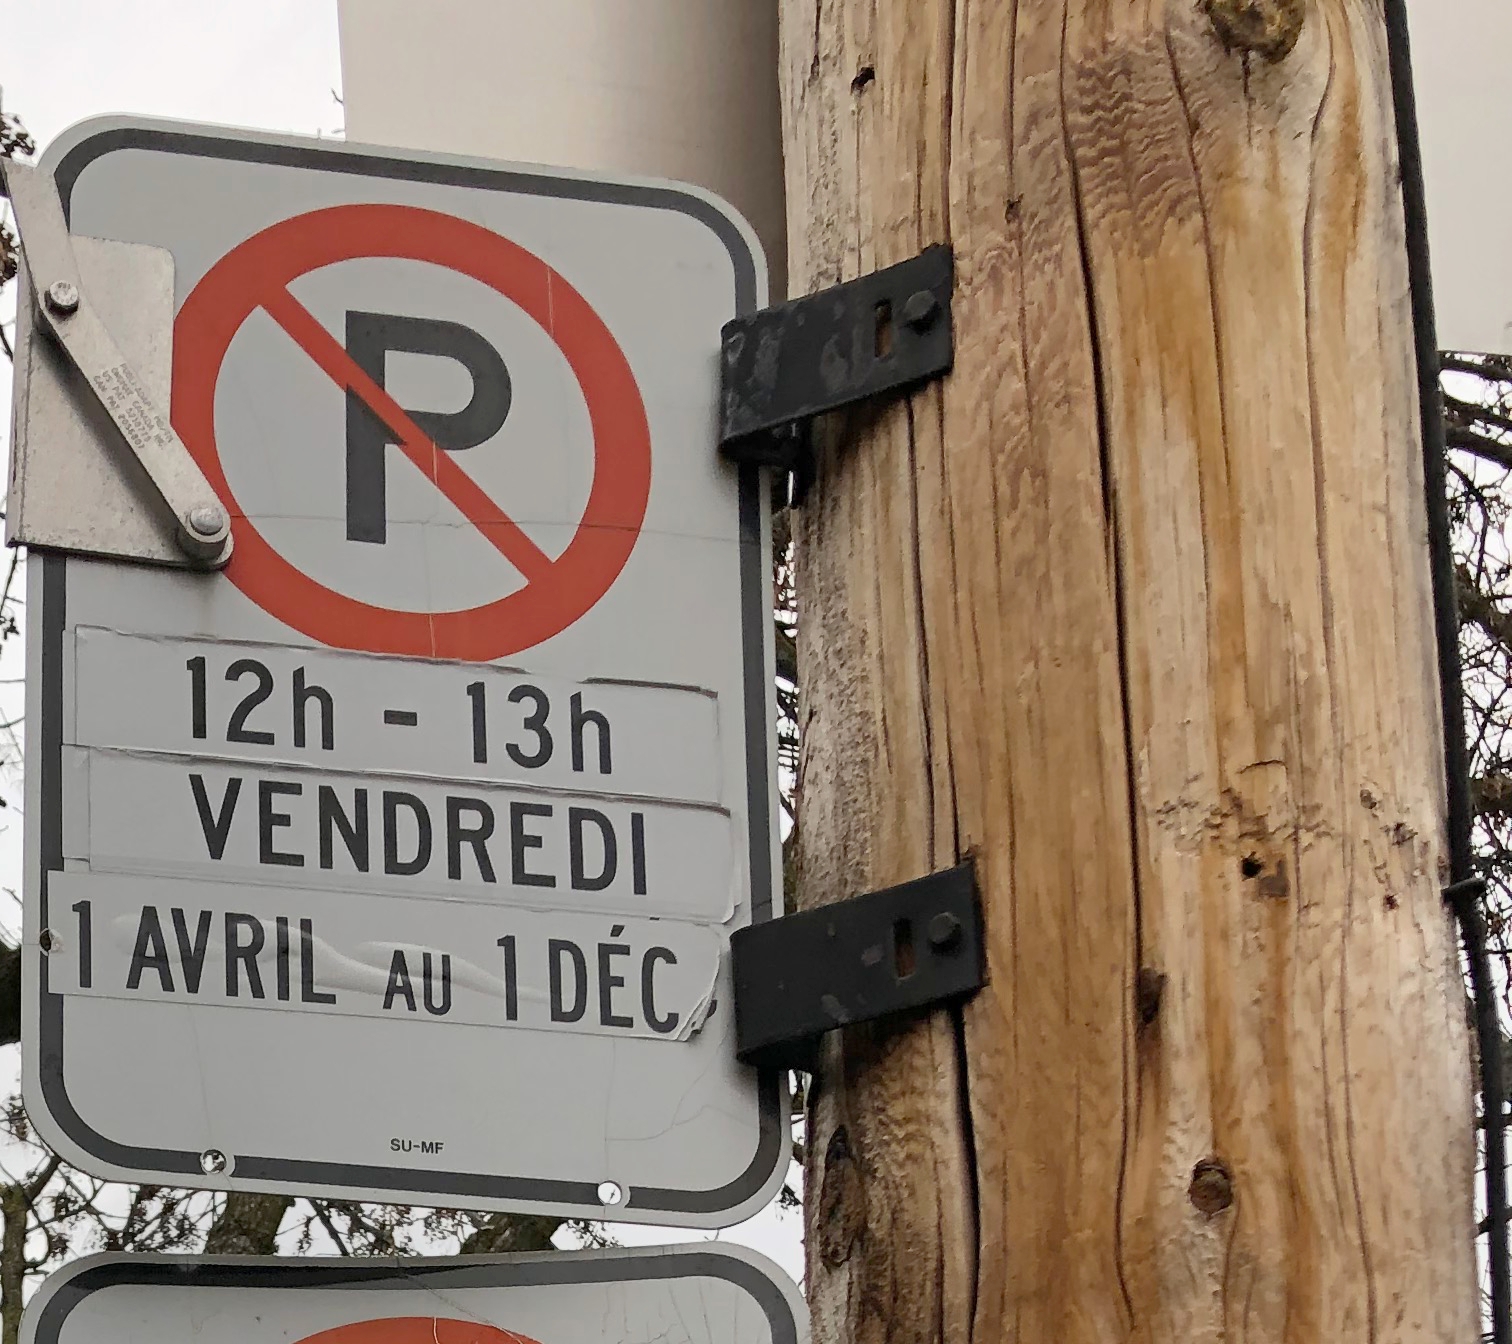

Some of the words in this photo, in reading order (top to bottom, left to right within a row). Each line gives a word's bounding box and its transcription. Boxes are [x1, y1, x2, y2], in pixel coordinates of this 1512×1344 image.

[345, 310, 512, 544] P
[186, 655, 335, 751] 12h
[466, 681, 612, 775] 13h
[188, 773, 647, 896] VENDREDI
[71, 899, 92, 989] 1
[125, 905, 337, 1005] AVRIL
[382, 949, 452, 1017] AU
[496, 934, 518, 1022] 1
[548, 924, 680, 1034] DÉC
[390, 1137, 444, 1154] SU-MF
